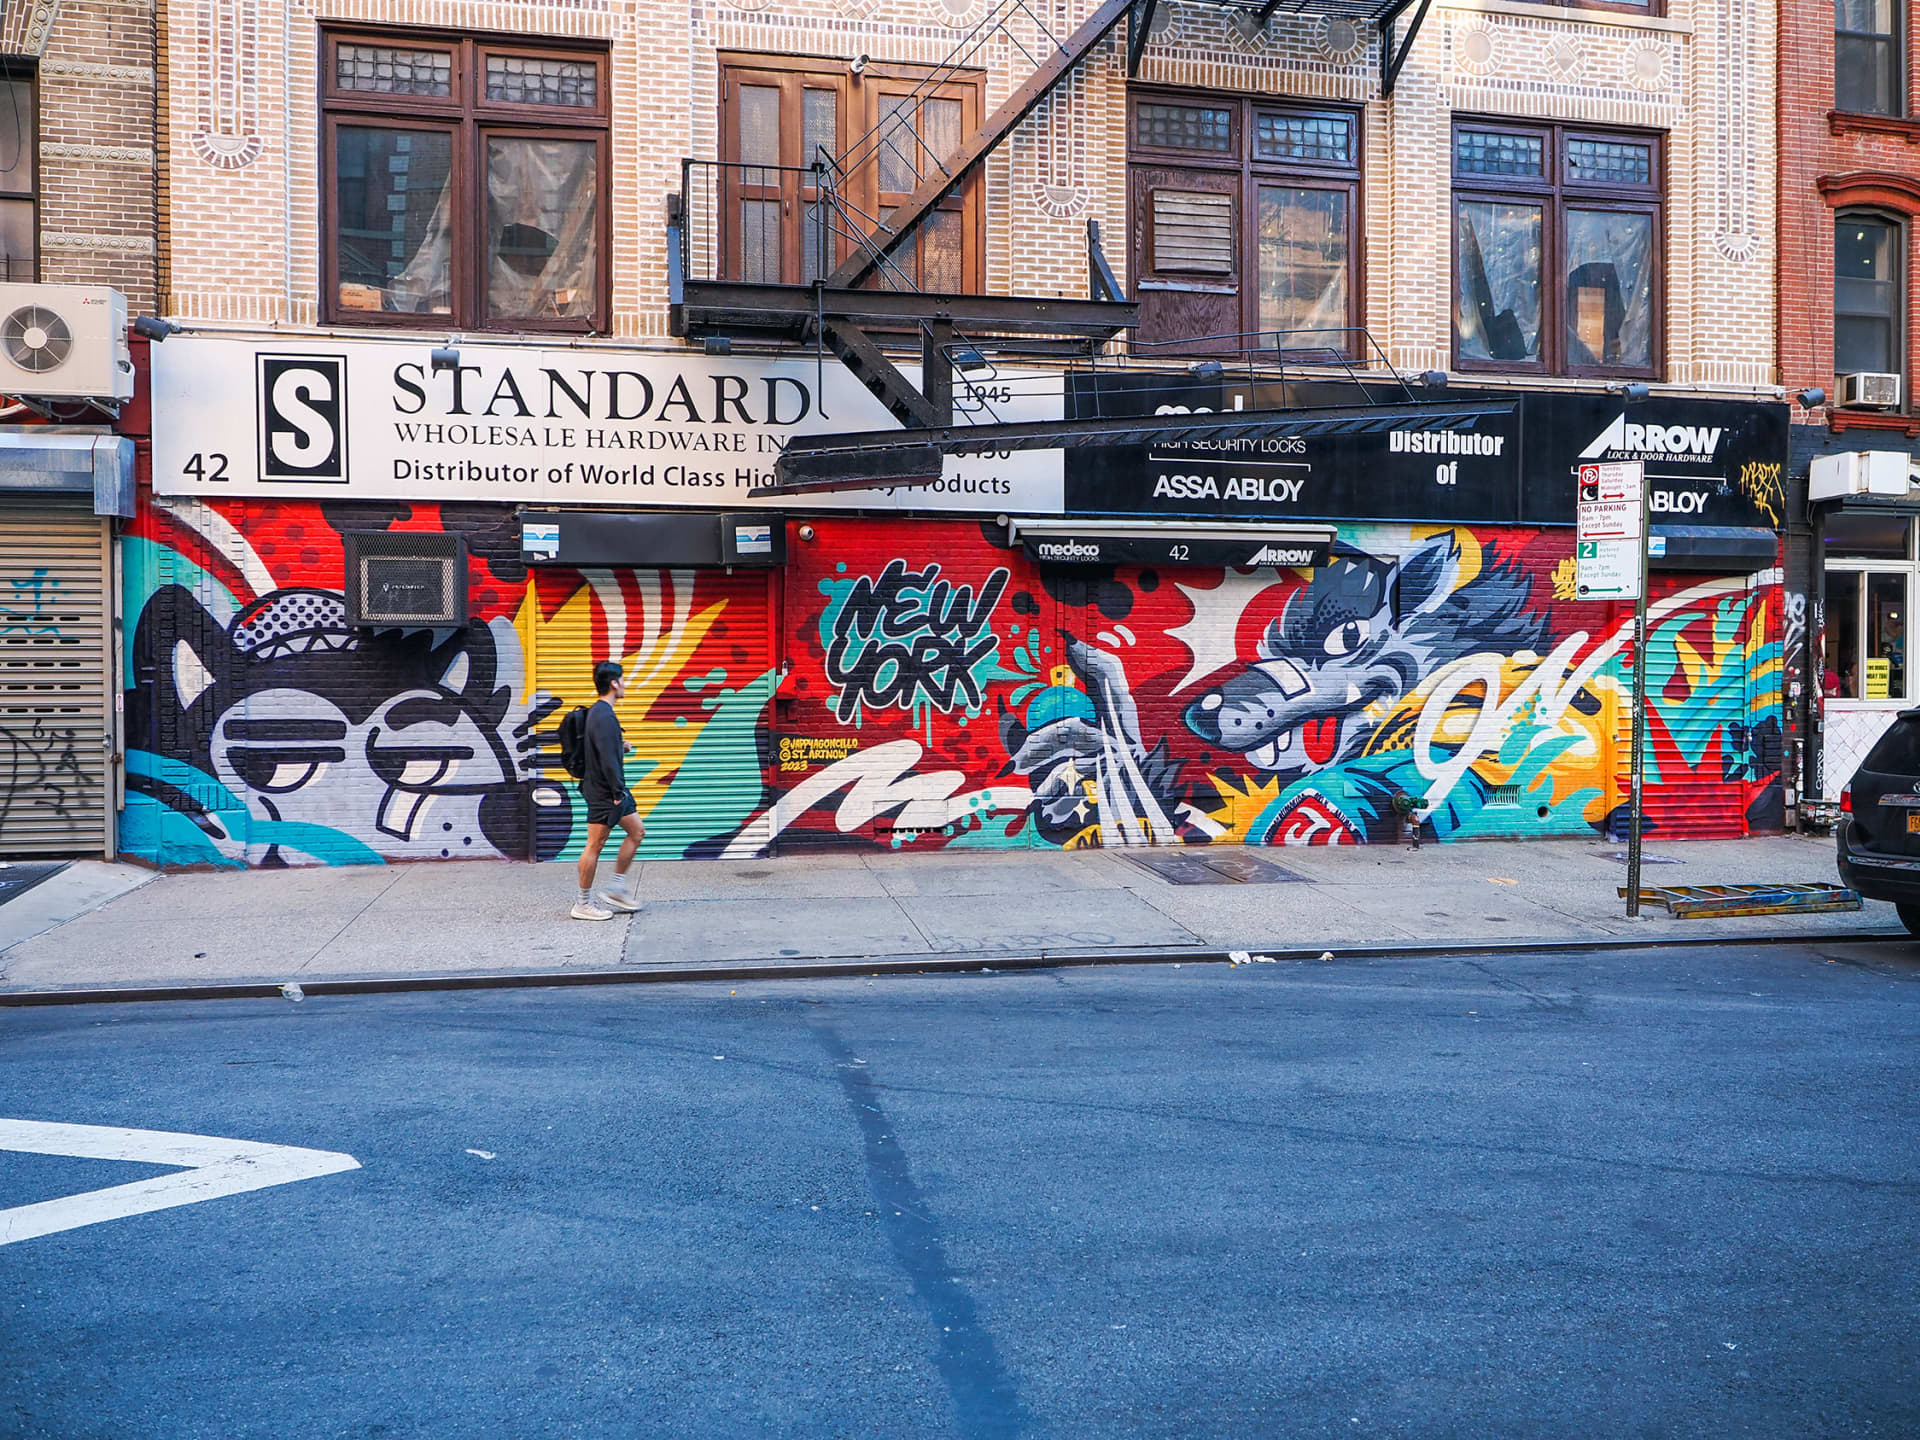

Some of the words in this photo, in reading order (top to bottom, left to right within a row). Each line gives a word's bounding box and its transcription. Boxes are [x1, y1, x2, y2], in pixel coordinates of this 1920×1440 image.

[392, 362, 811, 426] STANDARD
[963, 385, 1011, 403] 1945
[271, 368, 335, 469] S
[394, 422, 576, 448] WHOLESALE
[585, 429, 748, 453] HARDWARE
[1191, 438, 1259, 452] SECURITY
[1260, 439, 1306, 454] LOCKS
[1389, 430, 1505, 456] Distributor
[1577, 411, 1721, 458] ARROW
[182, 453, 230, 483] 42
[1607, 450, 1630, 461] LOCK
[1631, 451, 1638, 460] &
[1640, 452, 1664, 462] DOOR
[1665, 453, 1714, 464] HARDWARE
[393, 459, 539, 484] Distributor
[548, 461, 574, 485] of
[581, 464, 655, 488] World
[664, 465, 726, 489] Class
[907, 473, 1011, 494] oducts
[1435, 461, 1458, 485] of
[1152, 475, 1220, 500] ASSA
[1223, 477, 1305, 502] ABLOY
[1581, 505, 1592, 513] NO
[1594, 503, 1627, 513] PARKING
[1038, 539, 1100, 556] medeco
[1168, 544, 1189, 561] 42
[1245, 544, 1314, 566] ARROW
[1582, 542, 1593, 558] 2
[832, 558, 1011, 641] NEW
[825, 634, 1000, 726] YORK
[780, 760, 808, 772] 2023
